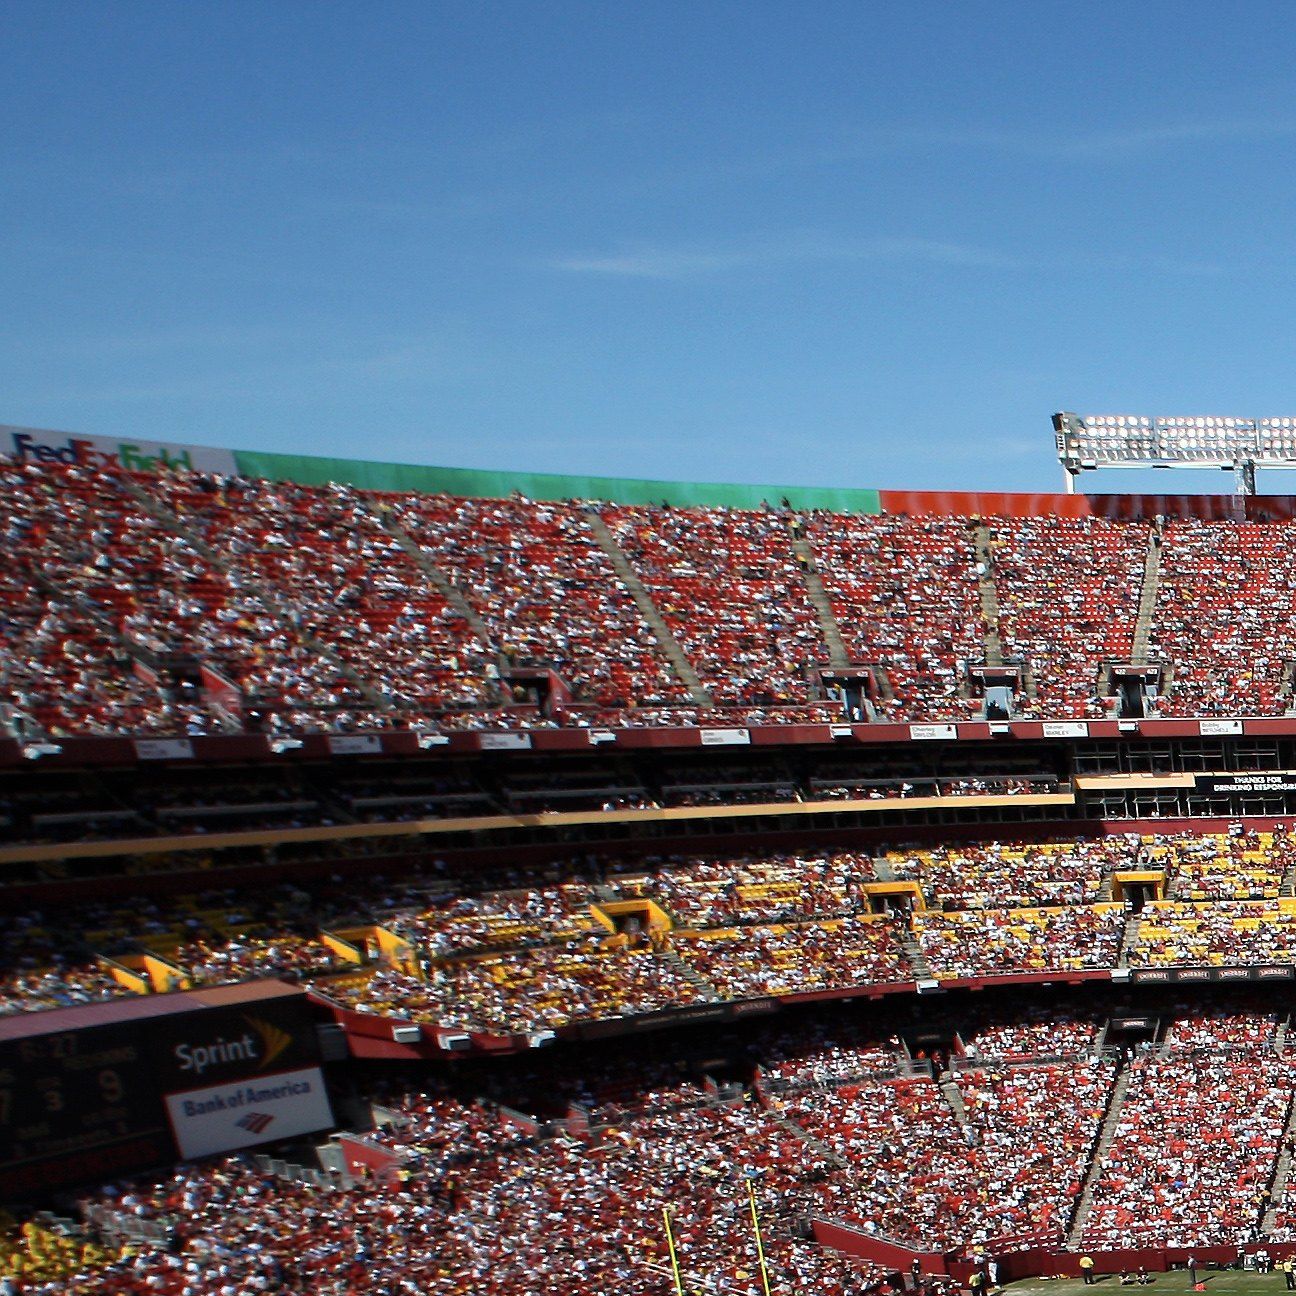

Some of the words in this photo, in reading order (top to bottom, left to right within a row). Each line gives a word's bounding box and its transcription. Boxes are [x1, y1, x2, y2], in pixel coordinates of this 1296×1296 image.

[174, 1034, 258, 1073] Sprint
[182, 1094, 227, 1117] Bank
[227, 1088, 245, 1108] of
[245, 1080, 312, 1105] America
